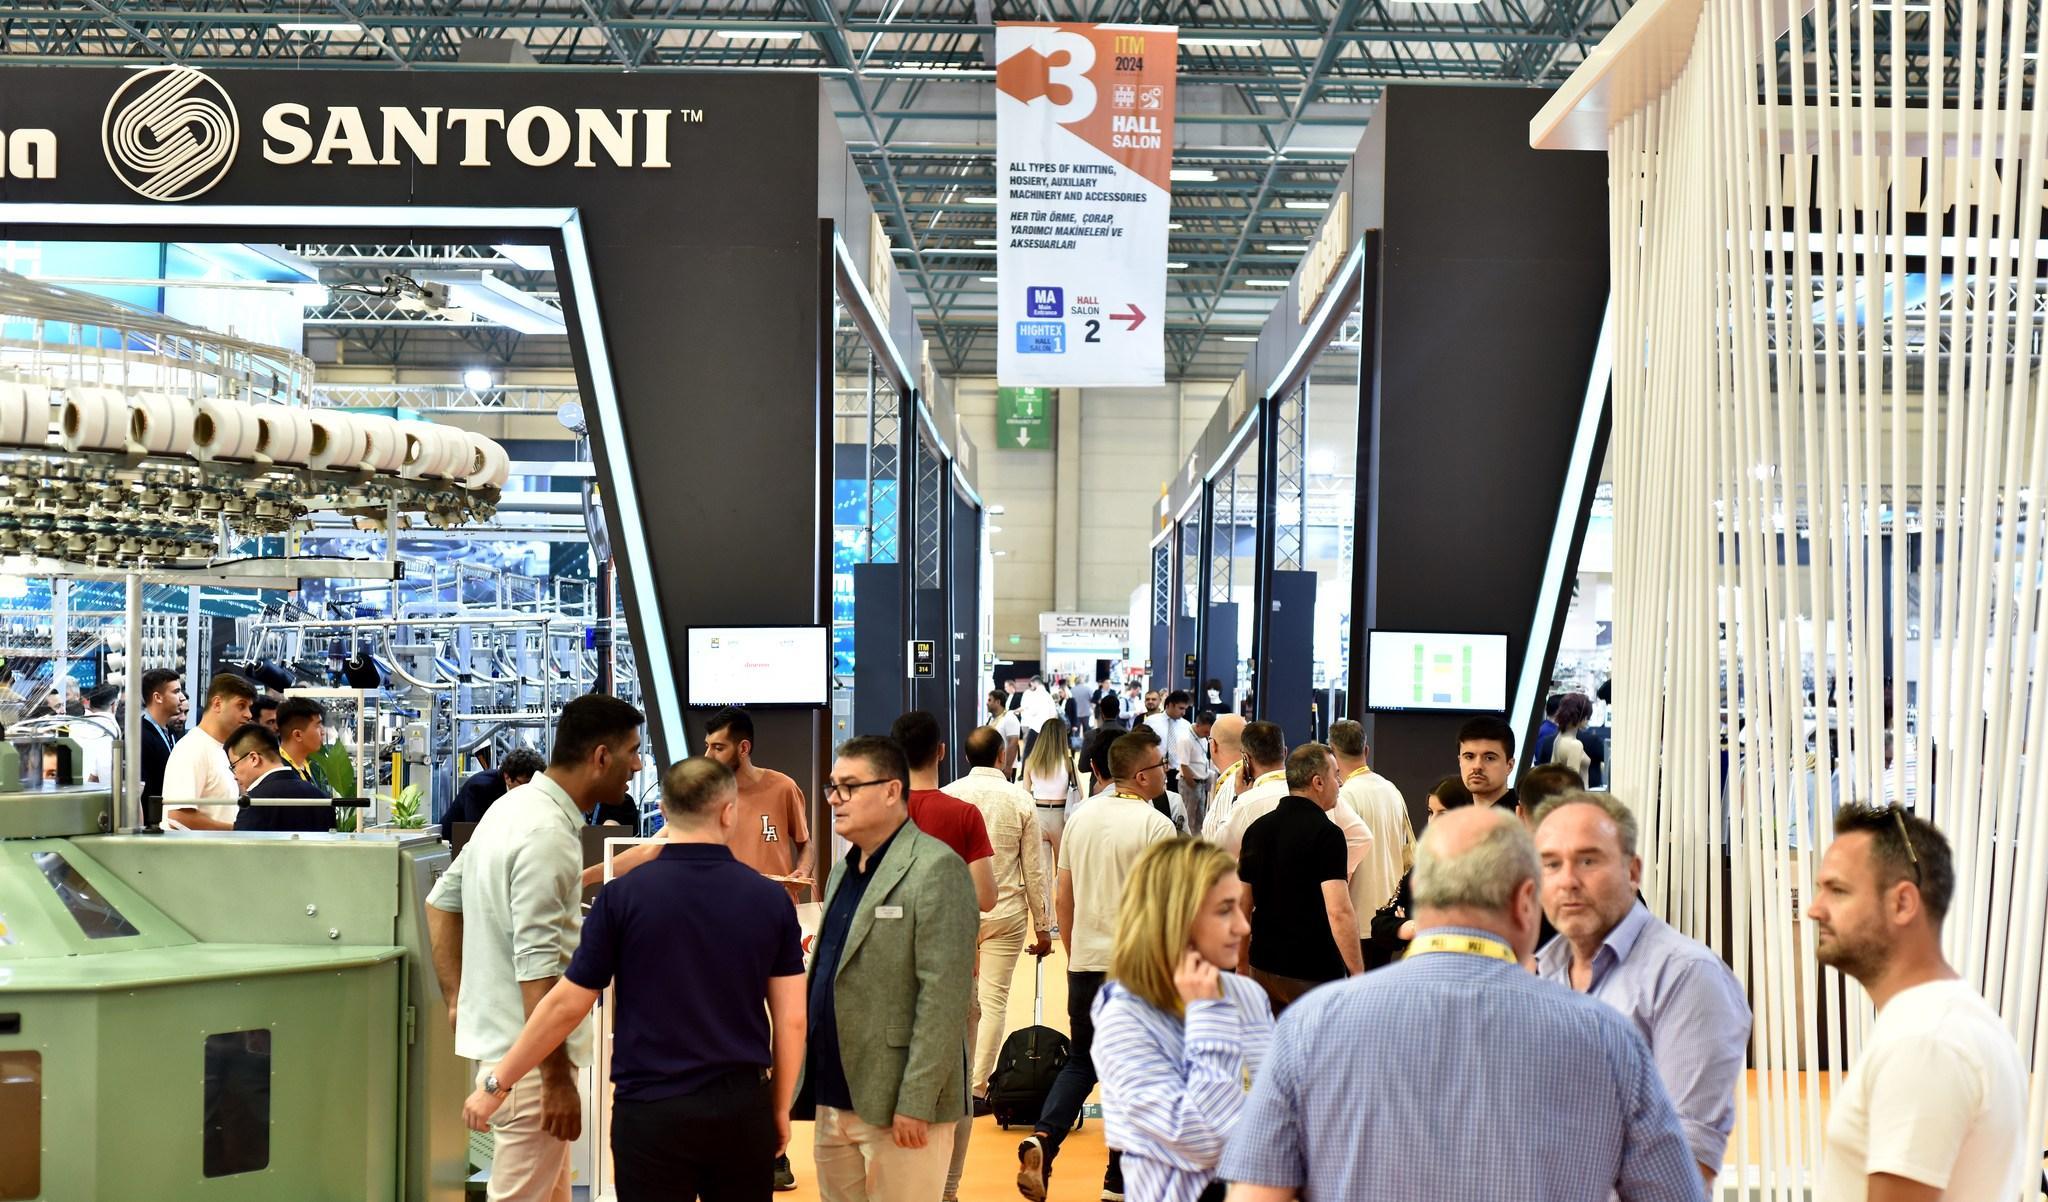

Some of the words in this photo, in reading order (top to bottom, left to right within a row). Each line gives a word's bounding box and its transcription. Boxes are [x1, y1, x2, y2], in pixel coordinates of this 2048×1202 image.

[1115, 36, 1145, 54] ITM
[1115, 56, 1144, 71] 2024
[1044, 31, 1098, 124] 3
[1112, 116, 1162, 133] HALL
[262, 102, 672, 168] SANTONI
[1112, 135, 1162, 149] SALON
[1009, 162, 1026, 172] ALL
[1029, 162, 1057, 173] TYPES
[1058, 164, 1070, 174] OF
[1072, 164, 1117, 176] KNITTING,
[1009, 176, 1050, 188] HOSIERY,
[1051, 177, 1097, 188] AUXILIARY
[1009, 189, 1062, 201] MACHINERY
[1064, 191, 1083, 201] AND
[1085, 192, 1147, 203] ACCESSORIES
[1010, 211, 1029, 221] HER
[1030, 210, 1047, 222] TÜR
[1049, 210, 1077, 224] ÖRME,
[1082, 213, 1114, 225] ÇORAP,
[1010, 225, 1052, 235] YARDIMCI
[1055, 225, 1110, 237] MAKİNELERİ
[1111, 227, 1124, 238] VE
[1009, 238, 1077, 250] AKSESUARLARI
[1035, 289, 1056, 304] MA
[1077, 296, 1099, 305] HALL
[1071, 306, 1100, 315] SALON
[1020, 324, 1063, 336] HIGHTEX
[1085, 319, 1101, 343] 2
[1054, 337, 1063, 352] 1
[1056, 616, 1085, 627] SET
[917, 643, 930, 651] ITM
[918, 666, 929, 674] 314
